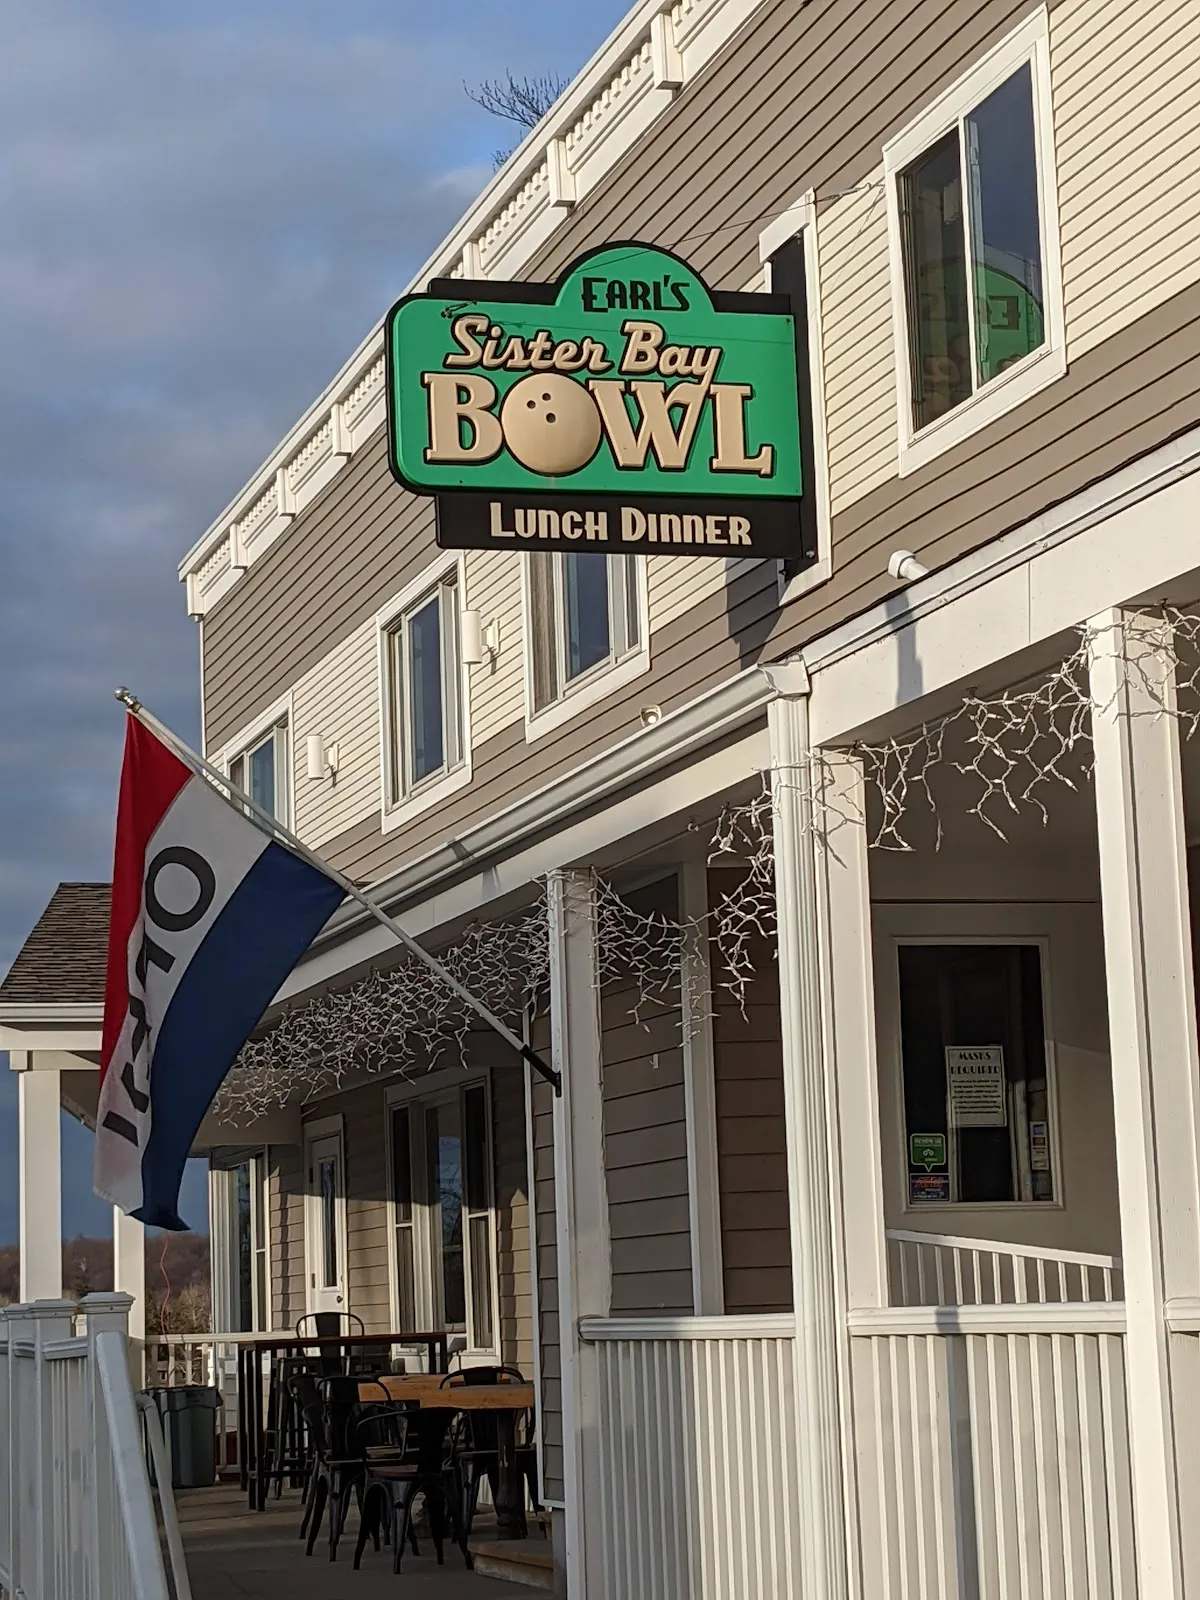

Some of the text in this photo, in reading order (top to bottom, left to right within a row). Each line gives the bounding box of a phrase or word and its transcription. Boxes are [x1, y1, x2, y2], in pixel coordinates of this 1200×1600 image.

[581, 275, 690, 313] EARL'S
[446, 315, 721, 388] Sister Bay
[423, 372, 773, 475] BOWL
[489, 502, 752, 546] LUNCH DINNER
